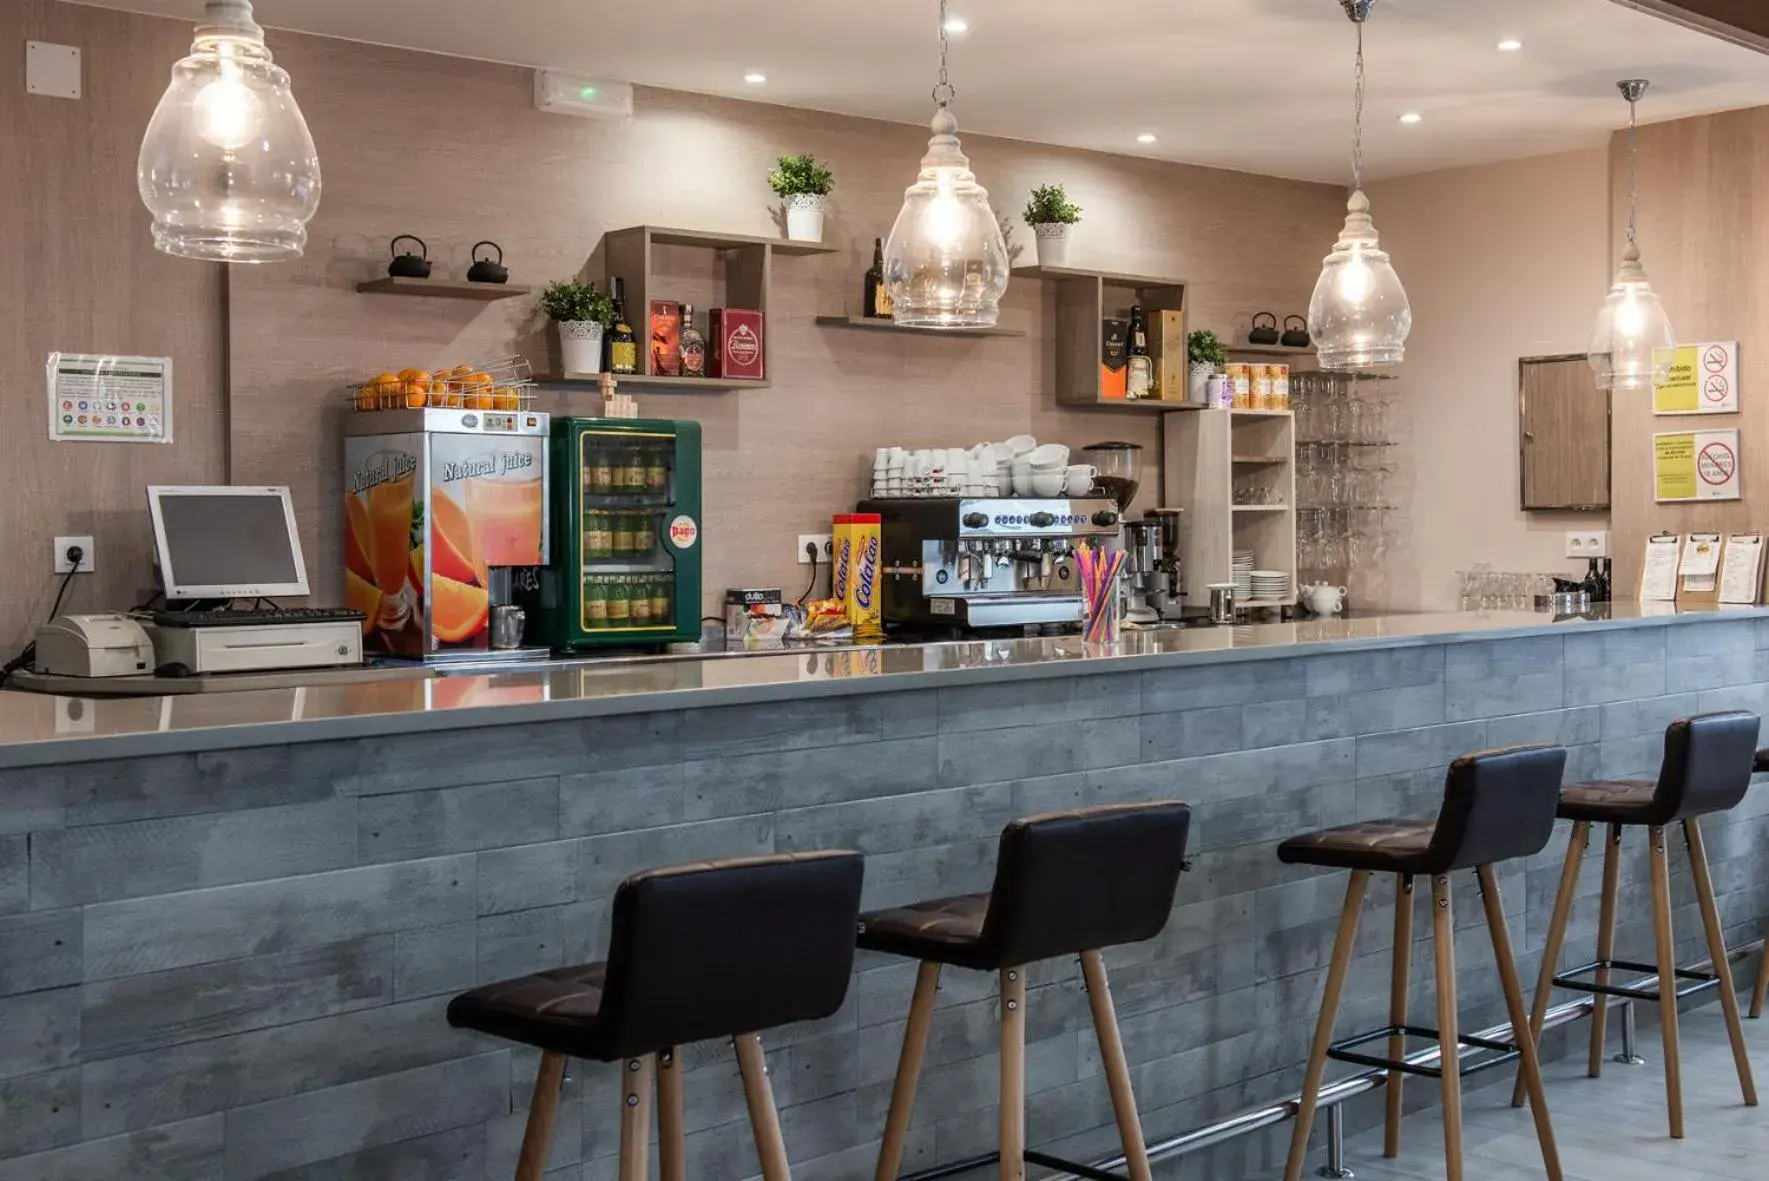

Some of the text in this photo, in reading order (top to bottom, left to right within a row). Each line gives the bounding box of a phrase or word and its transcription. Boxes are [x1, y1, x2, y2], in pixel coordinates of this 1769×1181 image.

[353, 454, 417, 494] Natural juice
[443, 452, 533, 482] Natural juice
[836, 538, 850, 600] ColaCao
[856, 536, 878, 609] ColaCao
